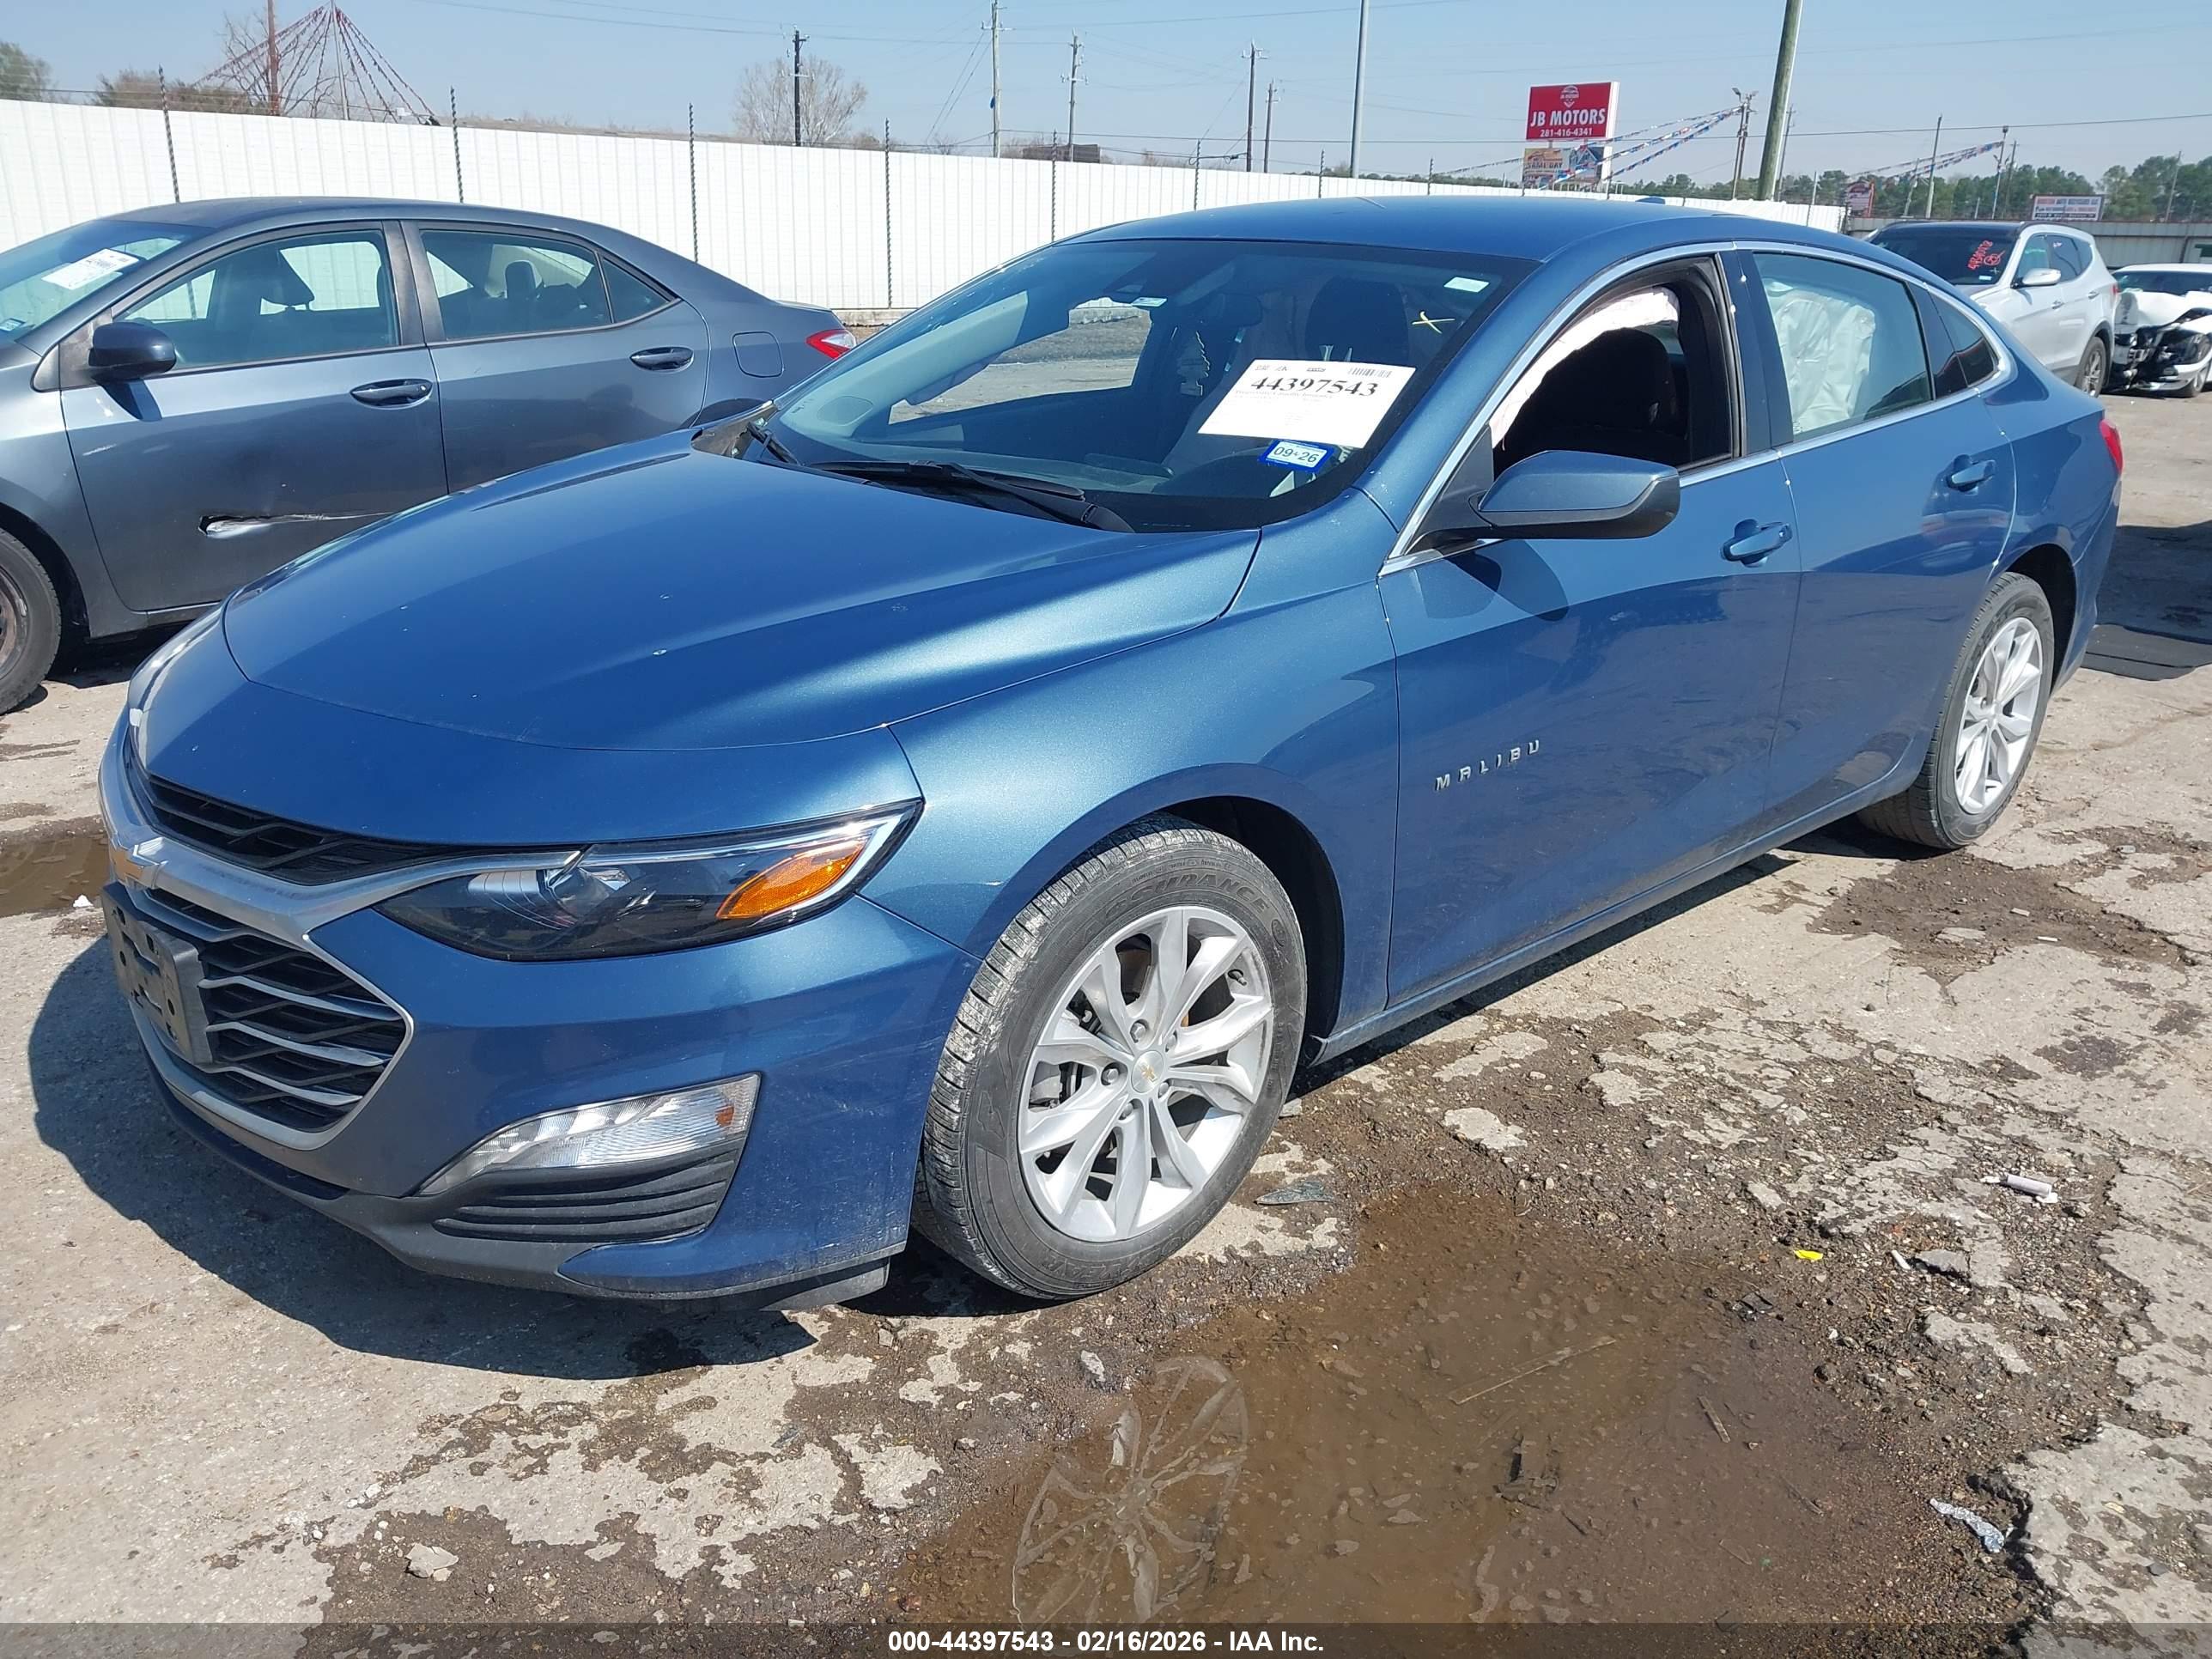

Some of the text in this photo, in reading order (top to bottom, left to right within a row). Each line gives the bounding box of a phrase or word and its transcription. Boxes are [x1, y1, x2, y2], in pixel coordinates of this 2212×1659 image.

[1530, 108, 1606, 127] JB MOTORS
[1540, 127, 1593, 137] 281-416-4341
[1251, 376, 1379, 397] 44397543
[1434, 739, 1540, 791] MALIBU
